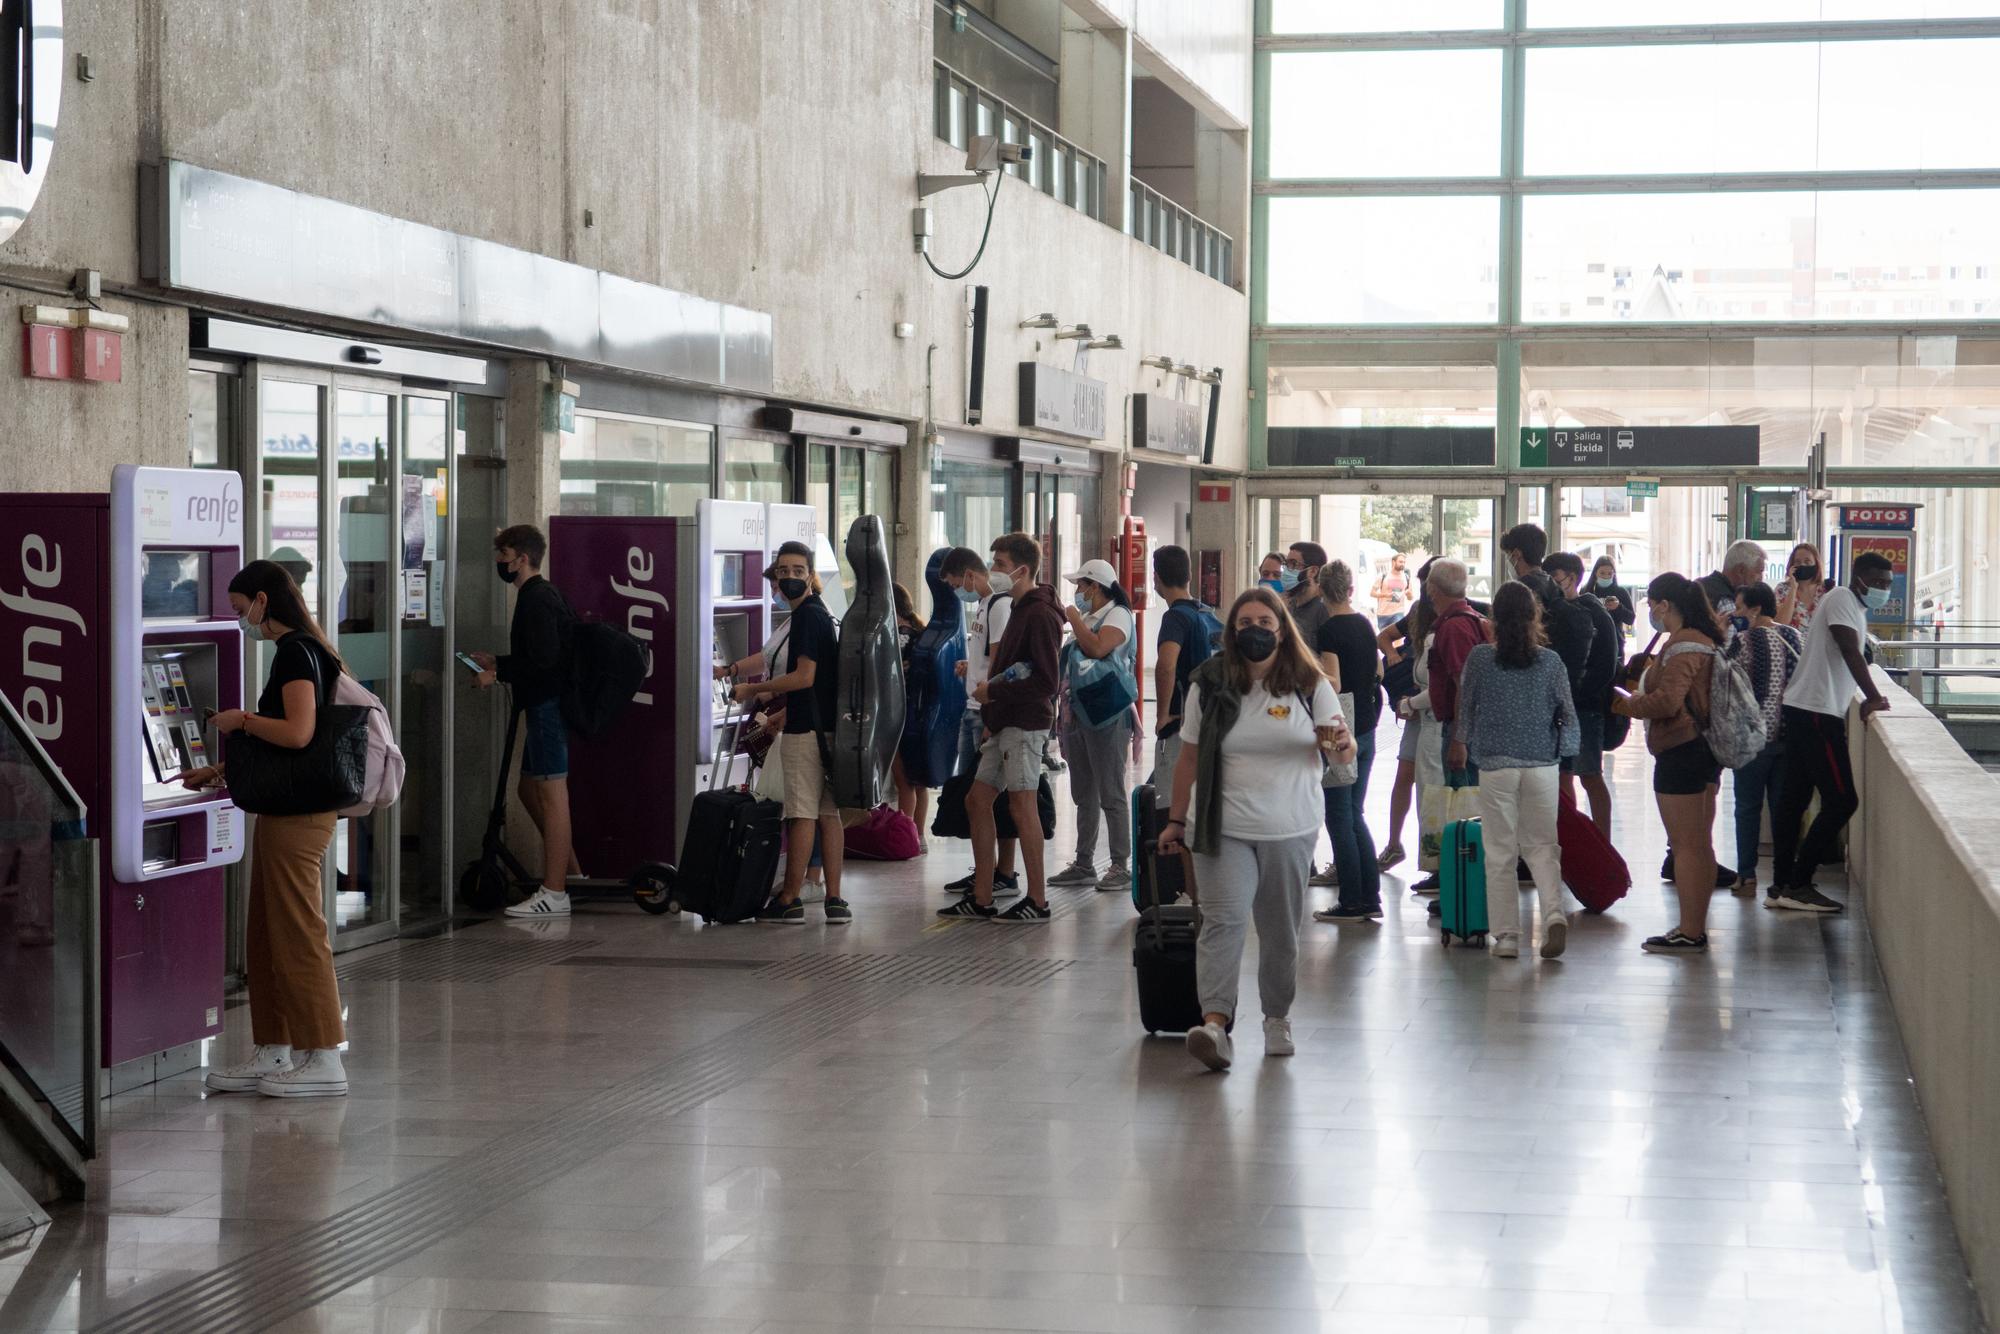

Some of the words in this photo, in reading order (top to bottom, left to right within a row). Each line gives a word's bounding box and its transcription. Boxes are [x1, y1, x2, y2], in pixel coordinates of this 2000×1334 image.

[1574, 431, 1601, 441] Salida
[1574, 443, 1603, 452] Eixida
[187, 481, 238, 537] renfe
[742, 509, 764, 544] renfe
[1849, 510, 1908, 521] FOTOS
[610, 547, 669, 704] rnfe
[0, 533, 87, 774] enfe
